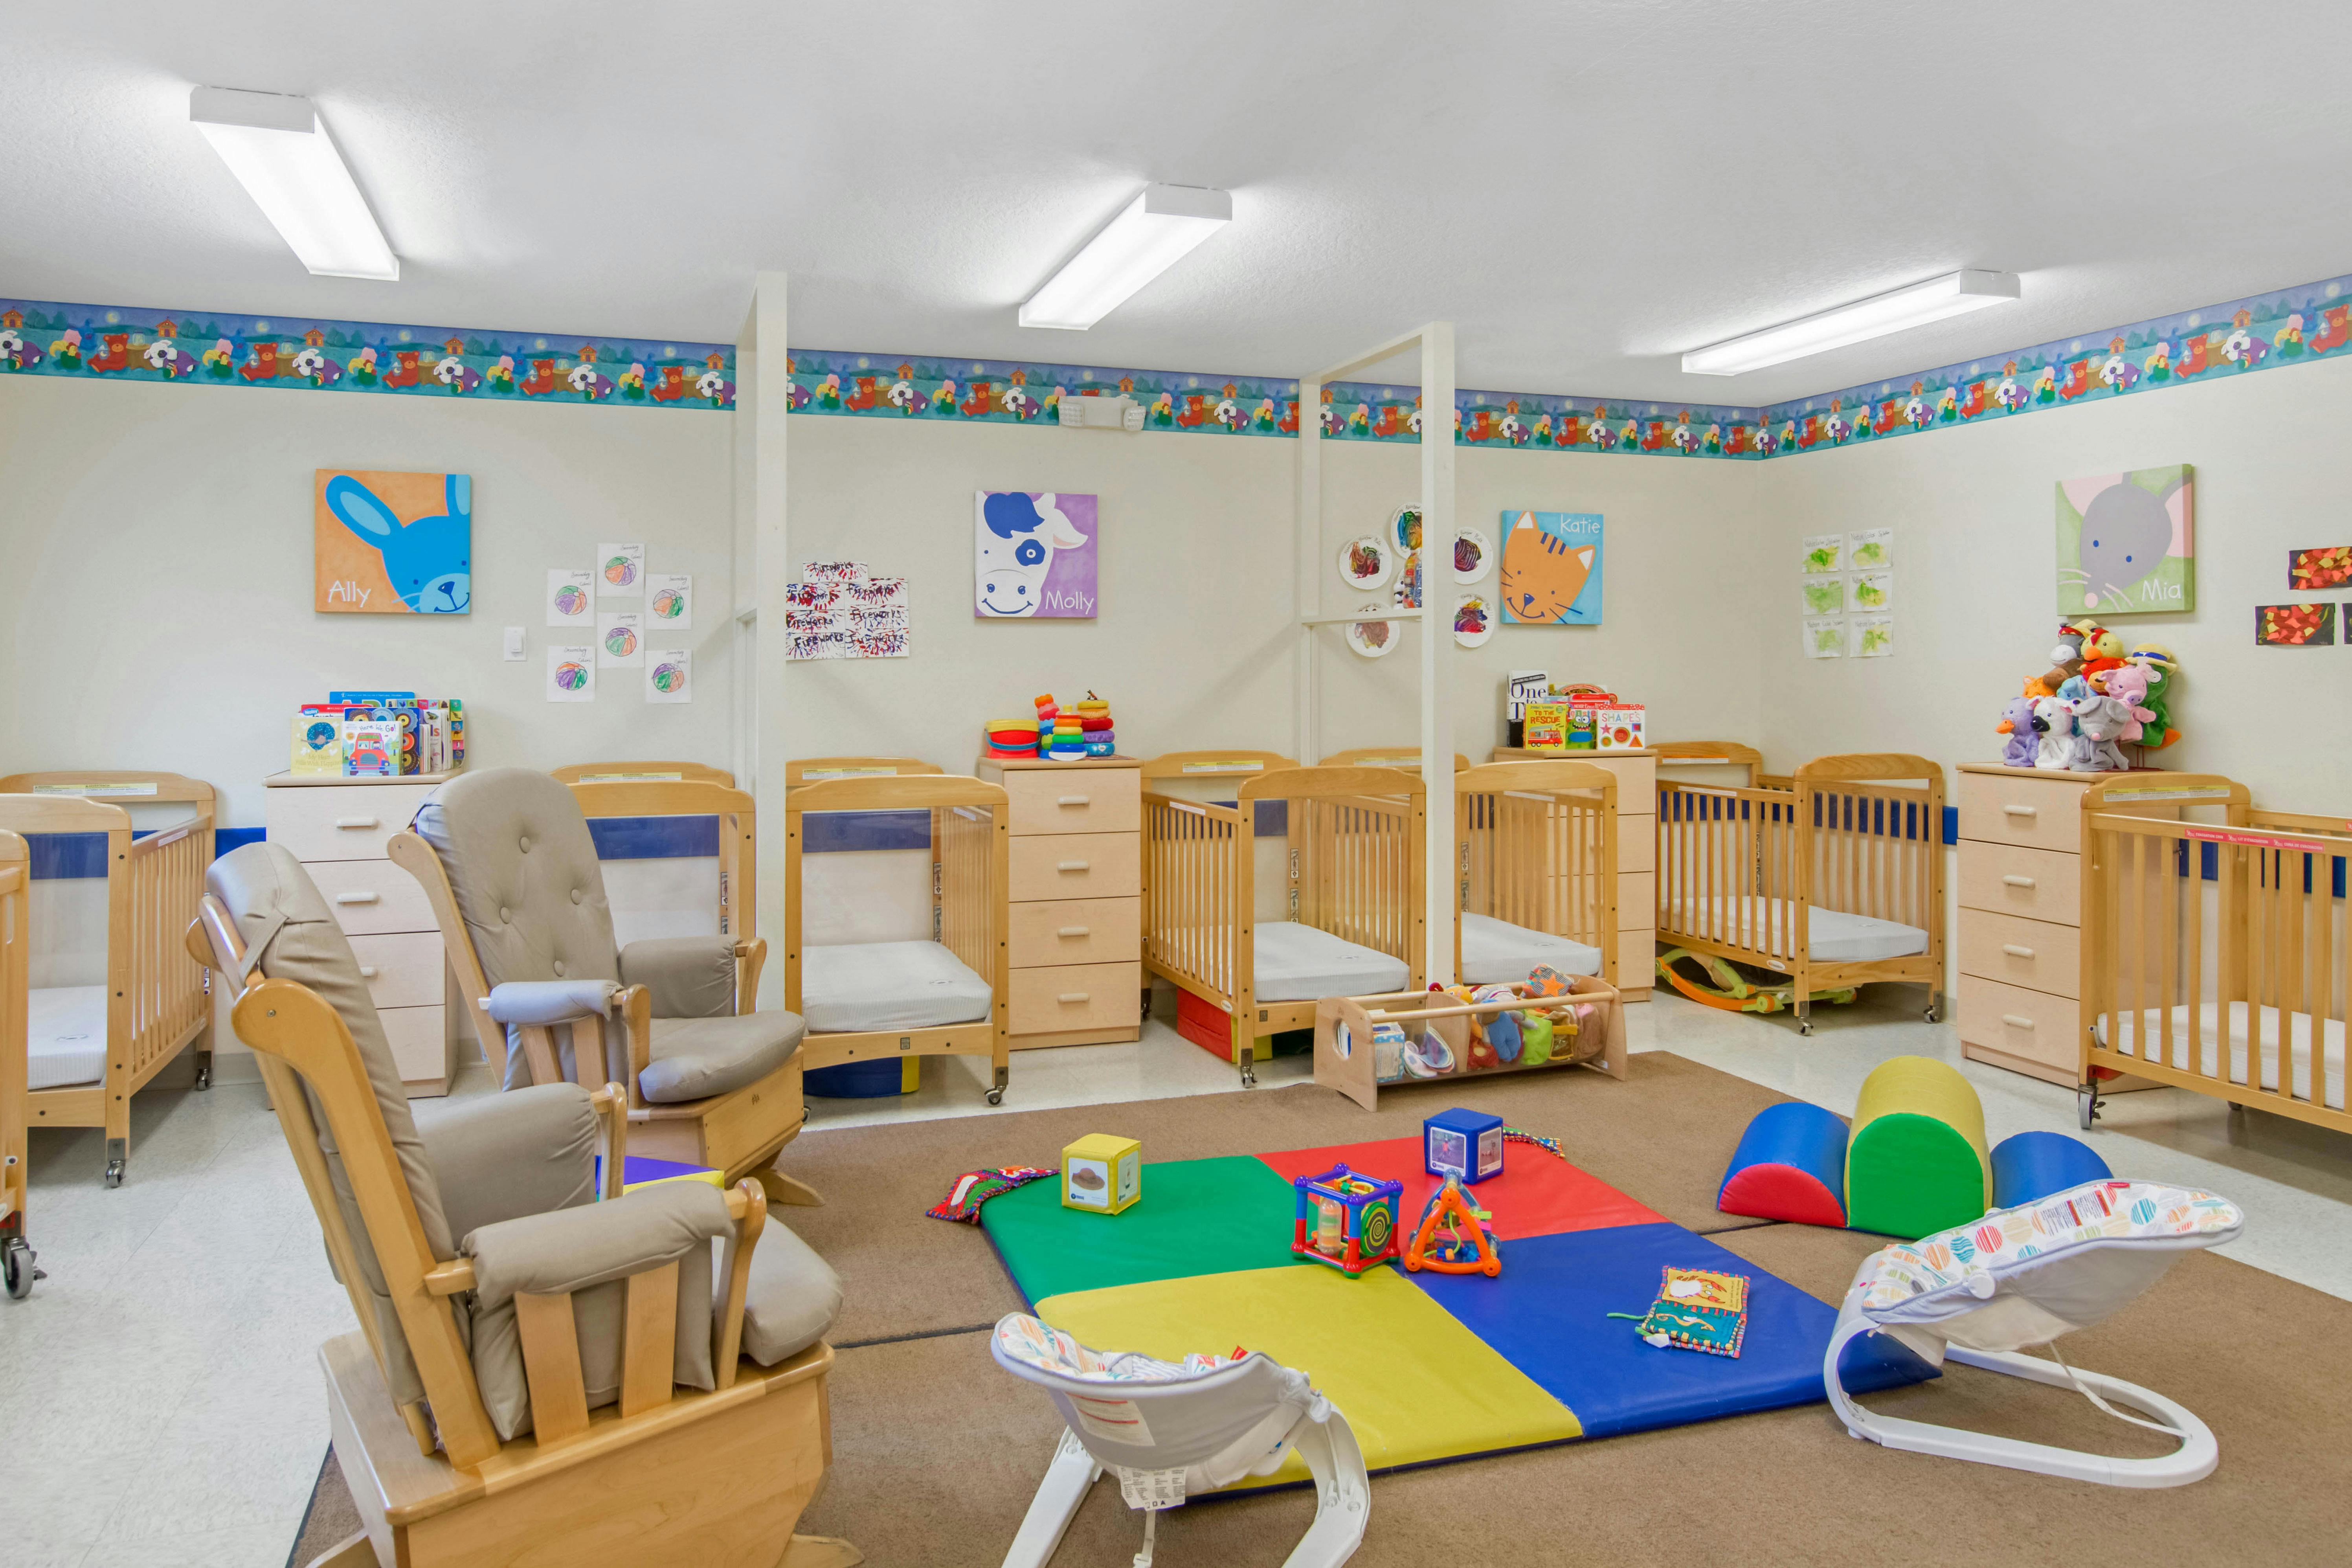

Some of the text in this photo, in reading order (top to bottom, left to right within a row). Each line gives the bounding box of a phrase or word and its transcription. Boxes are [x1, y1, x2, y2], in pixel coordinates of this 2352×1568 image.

[1560, 514, 1600, 534] Katie
[328, 580, 371, 608] Ally
[2142, 579, 2182, 601] Mia
[1045, 590, 1094, 614] Molly
[852, 610, 902, 621] Fireworks
[794, 633, 844, 648] Fireworks
[1511, 683, 1546, 699] One
[1602, 713, 1641, 722] SHAPES
[385, 723, 396, 732] Go!
